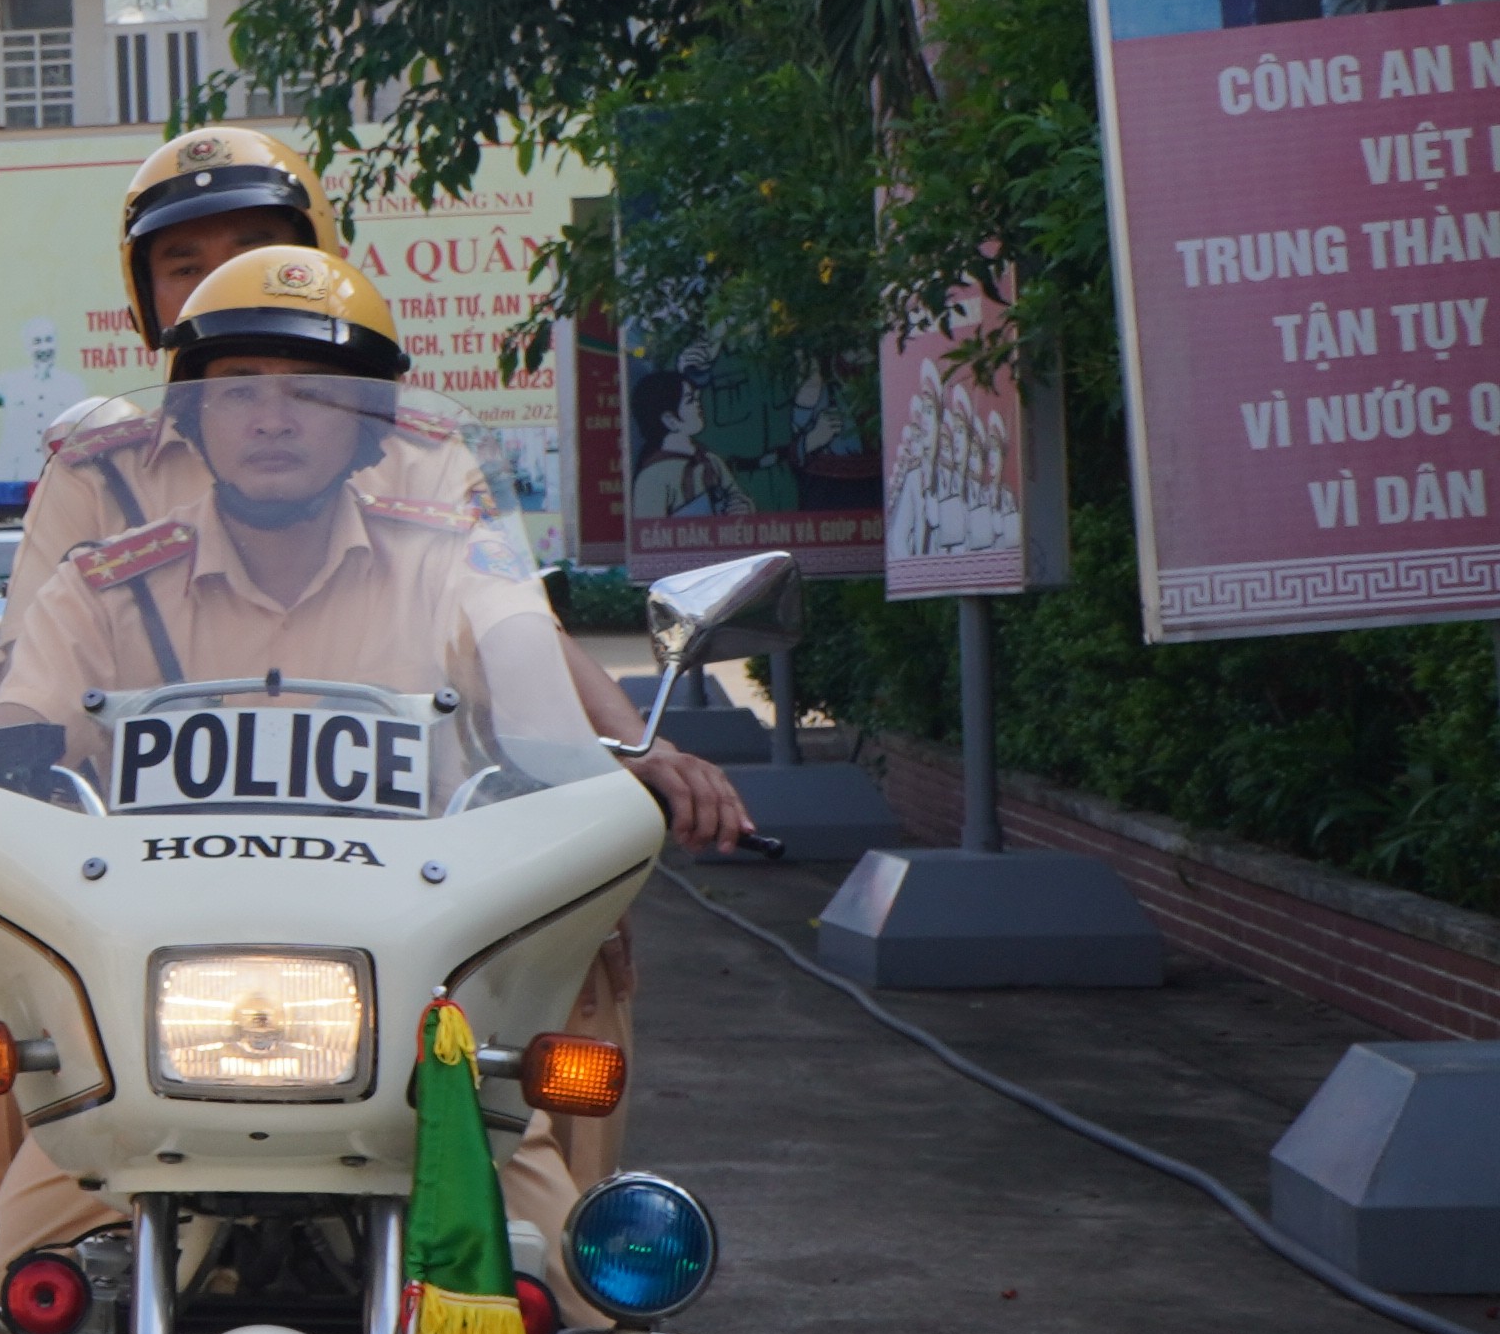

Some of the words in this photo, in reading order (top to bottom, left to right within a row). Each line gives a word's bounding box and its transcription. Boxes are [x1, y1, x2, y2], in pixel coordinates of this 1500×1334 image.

[1218, 53, 1362, 116] CÔNG
[1379, 44, 1454, 100] AN
[1361, 120, 1473, 192] VIỆT
[493, 191, 534, 209] NAI
[404, 225, 557, 284] QUÂN
[1176, 225, 1349, 288] TRUNG
[400, 292, 448, 323] TRẬT
[492, 294, 520, 316] AN
[1273, 301, 1378, 371] TẬN
[1391, 298, 1488, 361] TỤY
[81, 342, 128, 373] TRẬT
[450, 325, 486, 354] TẾT
[443, 364, 498, 392] XUÂN
[506, 369, 555, 390] 2023
[1241, 390, 1291, 452] VÌ
[1306, 382, 1454, 446] NƯỚC
[1308, 469, 1359, 530] VÌ
[1375, 463, 1486, 524] DÂN
[118, 711, 427, 811] POLICE
[141, 835, 385, 868] HONDA
